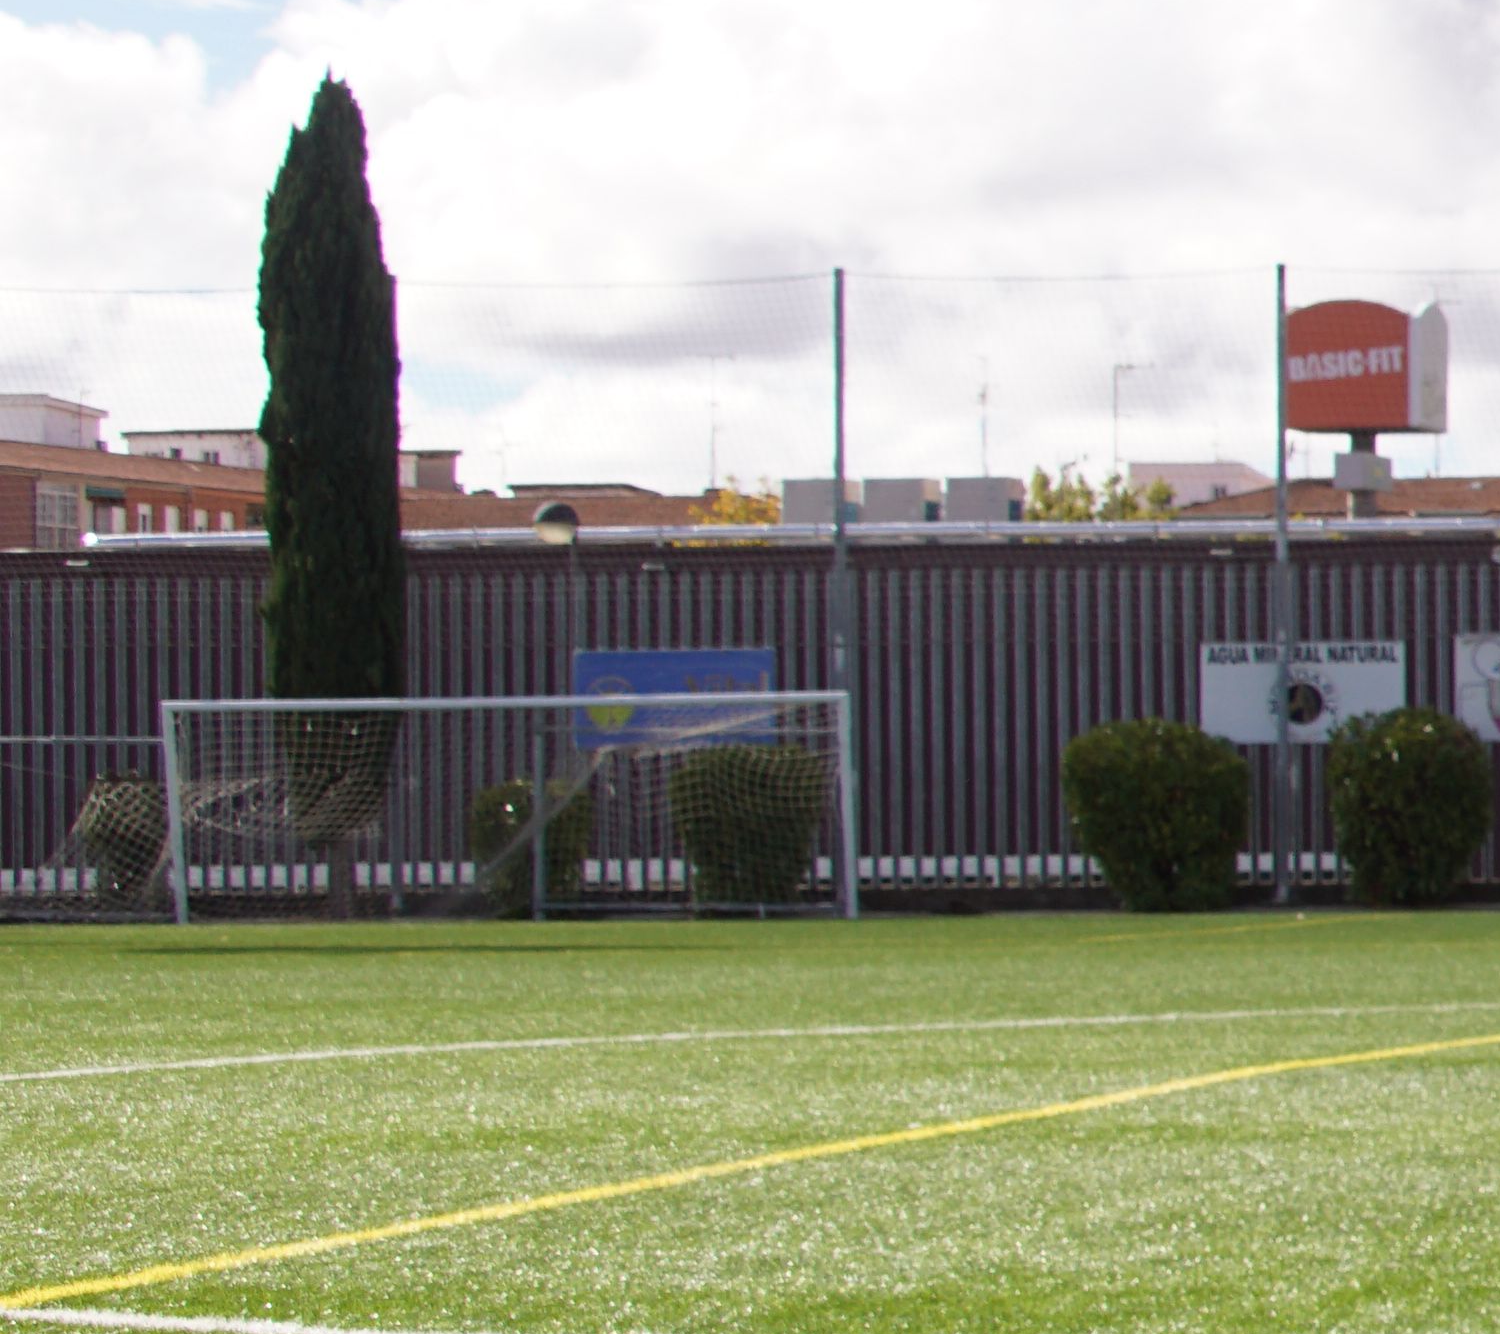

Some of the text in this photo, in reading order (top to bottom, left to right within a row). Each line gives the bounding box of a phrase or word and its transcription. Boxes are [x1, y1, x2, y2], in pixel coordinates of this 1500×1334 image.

[1207, 644, 1397, 664] AGUA MINRAL NATURAL
